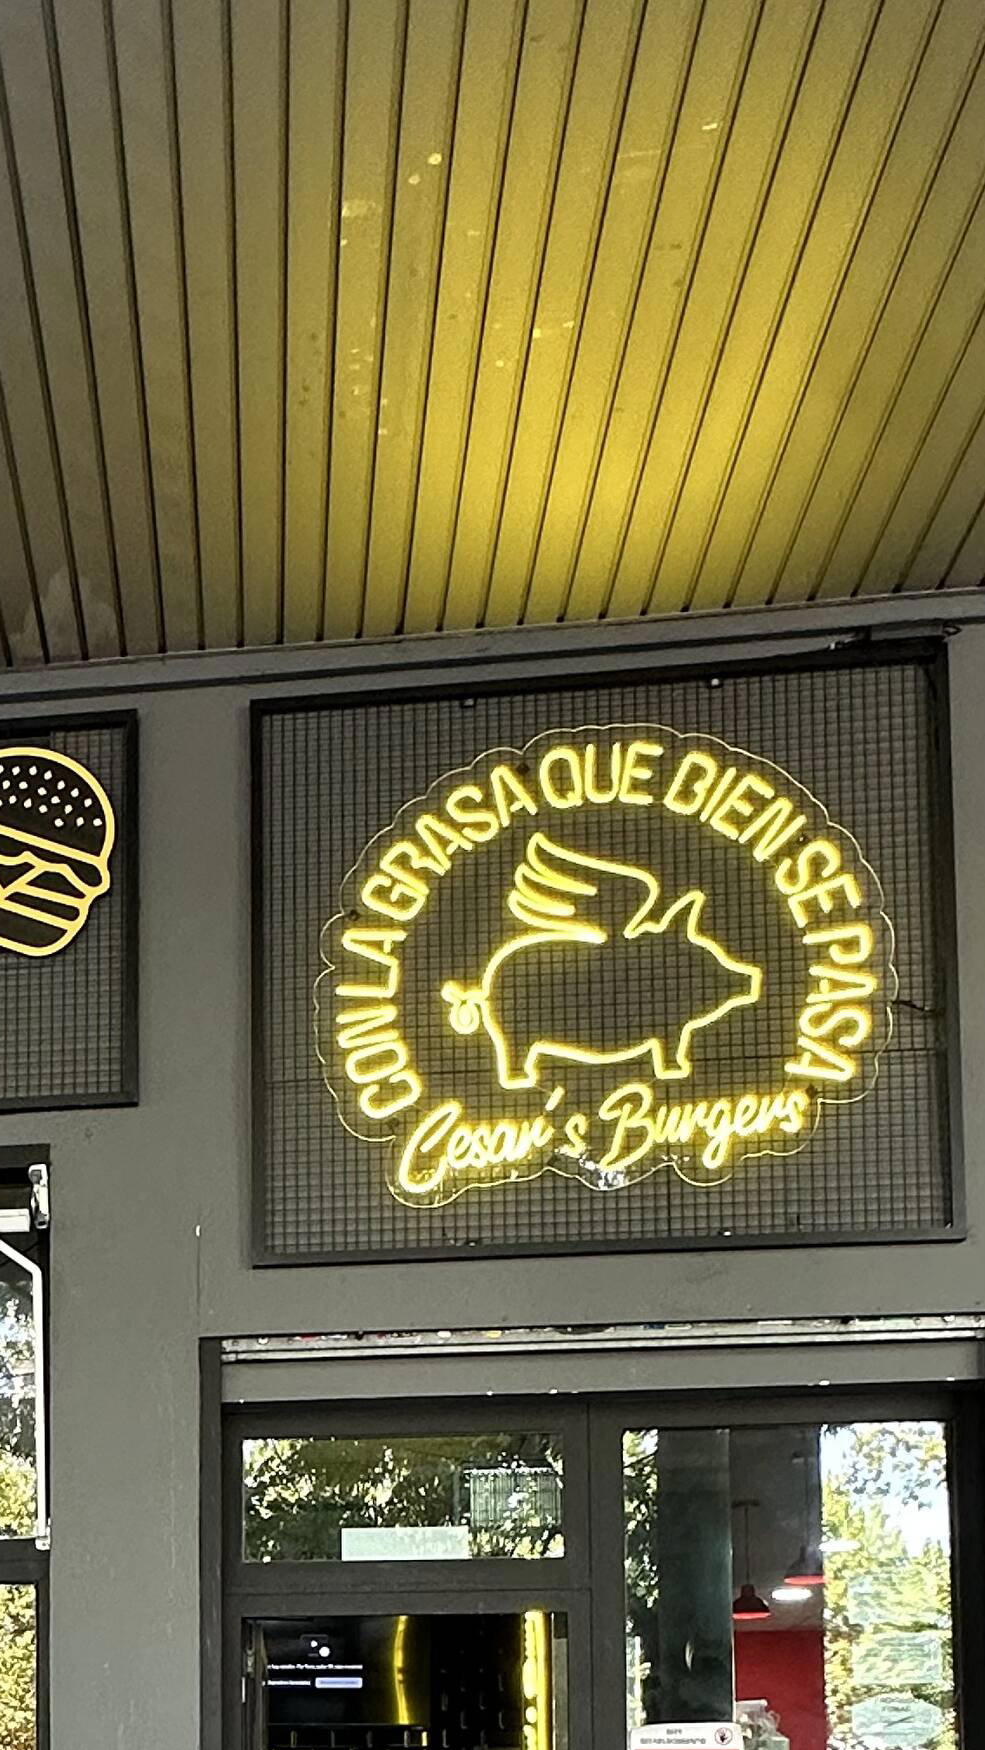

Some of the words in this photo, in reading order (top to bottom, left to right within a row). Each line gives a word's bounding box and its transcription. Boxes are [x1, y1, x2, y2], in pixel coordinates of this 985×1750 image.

[538, 741, 664, 809] QUE
[664, 752, 807, 861] BIEN
[361, 764, 538, 921] GRASA
[775, 839, 864, 928] SE
[335, 926, 408, 997] LA
[786, 921, 878, 1082] PASA
[336, 1004, 420, 1121] CON
[400, 1087, 588, 1193] Cesar's
[598, 1083, 812, 1169] Burgers
